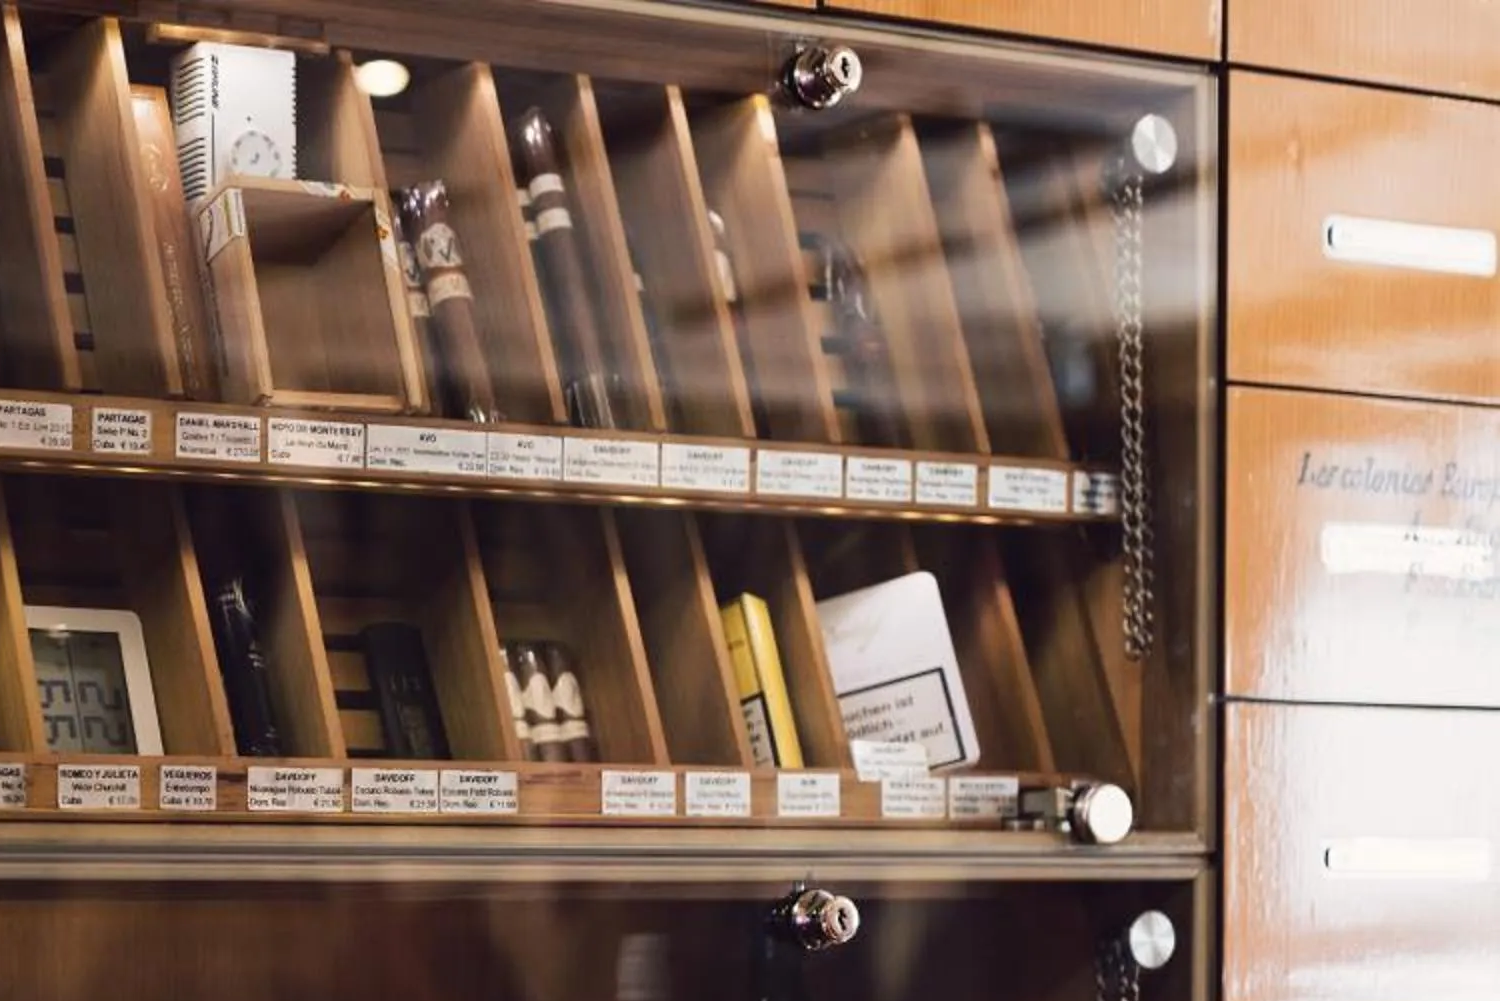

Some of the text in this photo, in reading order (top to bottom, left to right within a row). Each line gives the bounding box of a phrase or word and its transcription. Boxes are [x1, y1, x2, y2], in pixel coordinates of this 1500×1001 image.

[97, 413, 148, 425] PARTAGAS
[309, 425, 362, 439] MONTERREY
[59, 768, 92, 780] ROMEO
[101, 769, 139, 781] JULIETA
[164, 770, 213, 782] VEGUEROS
[274, 772, 317, 783] DAVIDOFF
[374, 773, 415, 784] DAVIDOFF
[459, 774, 499, 785] DAVIDOFF
[61, 796, 83, 806] Cuba
[162, 796, 182, 806] Cuba
